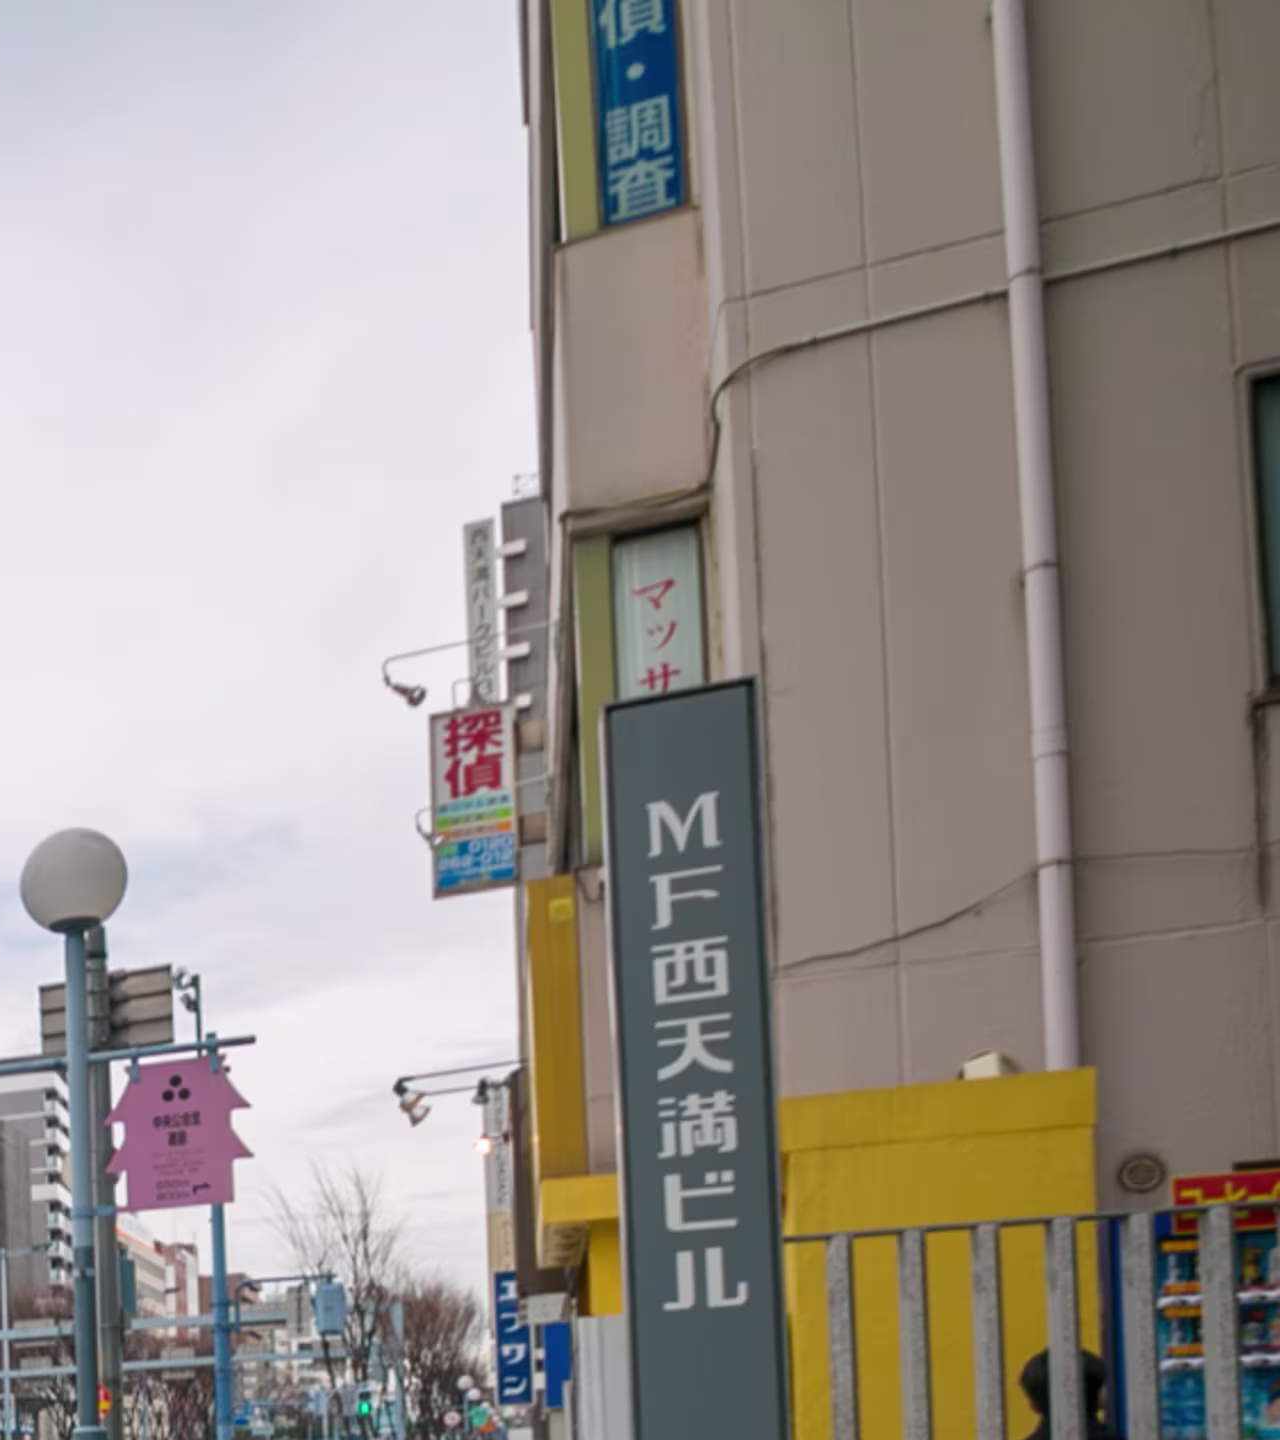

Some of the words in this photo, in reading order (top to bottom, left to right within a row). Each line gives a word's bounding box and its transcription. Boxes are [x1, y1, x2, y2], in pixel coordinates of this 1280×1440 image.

[444, 709, 504, 799] 探偵
[646, 790, 748, 1310] MF西天満ビル
